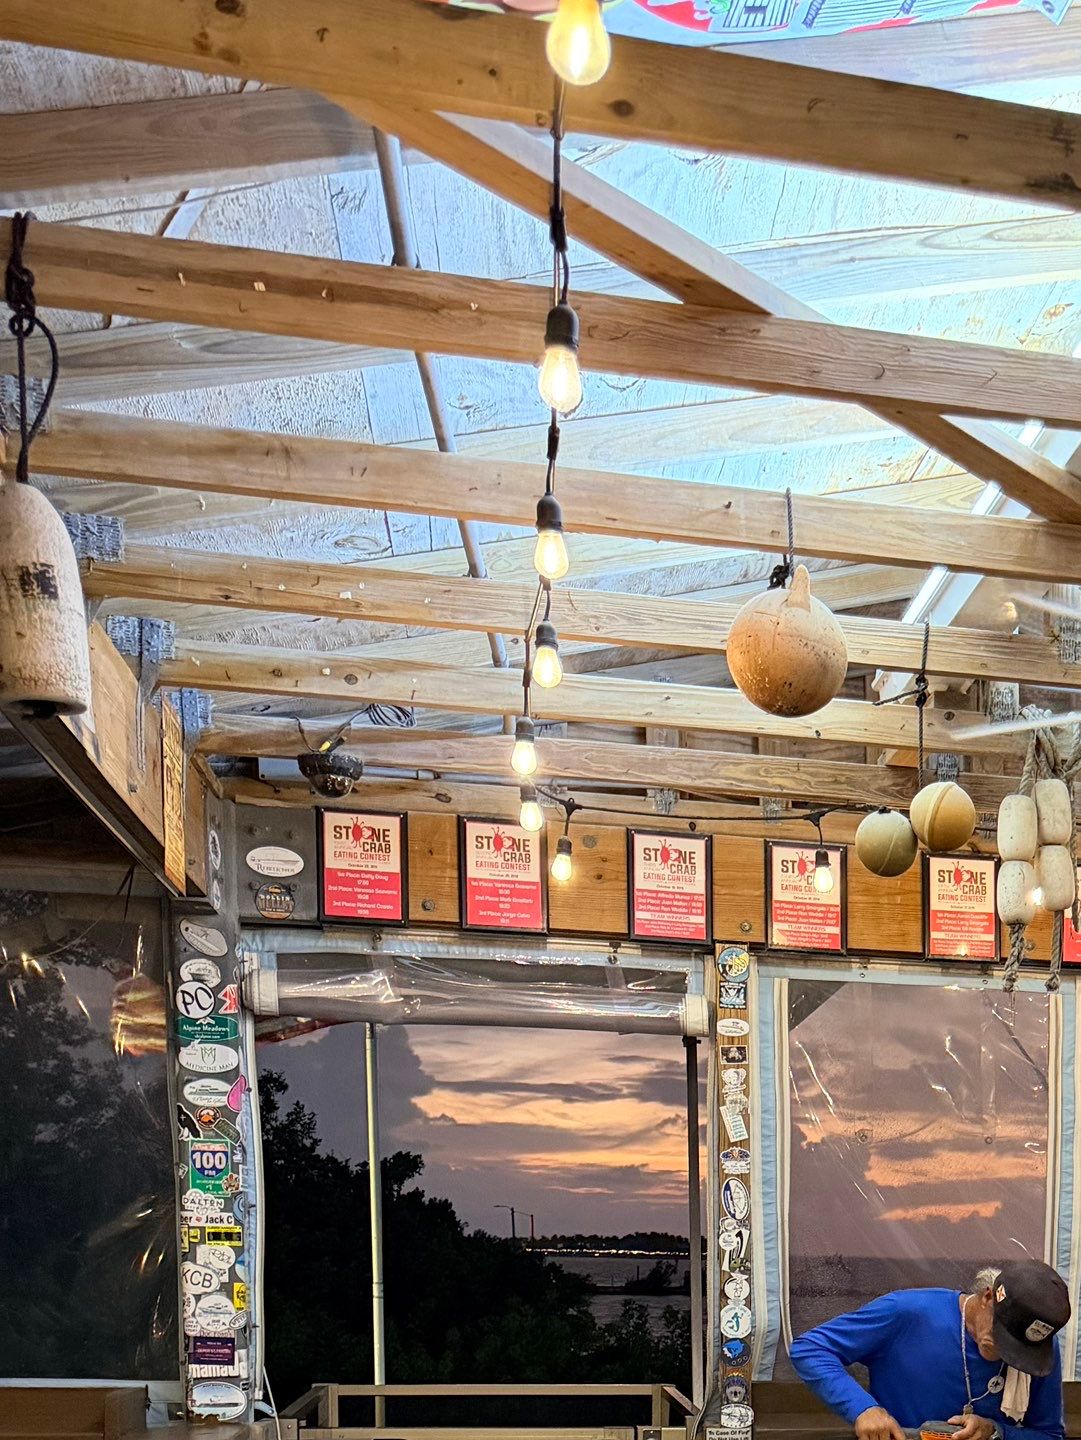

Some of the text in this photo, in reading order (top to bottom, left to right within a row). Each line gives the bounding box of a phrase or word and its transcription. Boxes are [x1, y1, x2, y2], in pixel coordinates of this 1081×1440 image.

[363, 842, 391, 853] CRAB
[334, 851, 390, 861] EATING CONTEST
[503, 852, 531, 863] CRAB
[475, 861, 530, 871] EATING CONTEST
[670, 864, 696, 875] CRAB
[643, 872, 696, 883] EATING CONTEST
[781, 884, 802, 892] EATING
[962, 885, 987, 895] CRAB
[181, 987, 213, 1015] PC
[185, 1061, 233, 1071] MEDICINE MAN
[193, 1152, 226, 1169] 100
[183, 1197, 223, 1206] DALTON
[205, 1215, 233, 1224] Jack C
[182, 1268, 213, 1288] KCB
